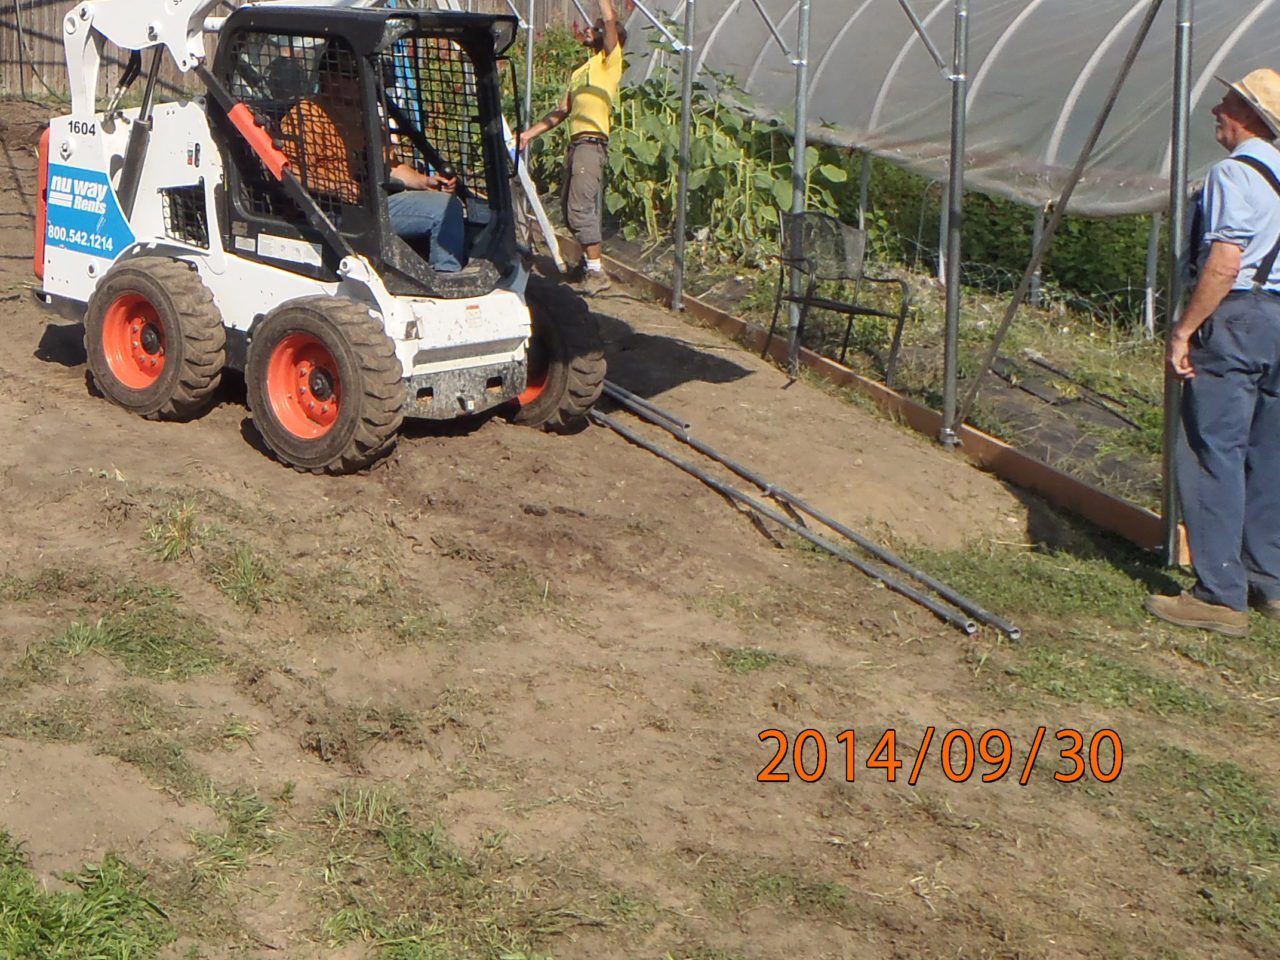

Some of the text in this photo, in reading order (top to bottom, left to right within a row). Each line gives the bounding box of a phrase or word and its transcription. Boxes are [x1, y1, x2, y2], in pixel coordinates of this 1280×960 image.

[68, 120, 96, 136] 1604
[50, 175, 109, 202] nu way
[73, 195, 107, 215] Rents
[47, 224, 114, 252] 800.542.1214
